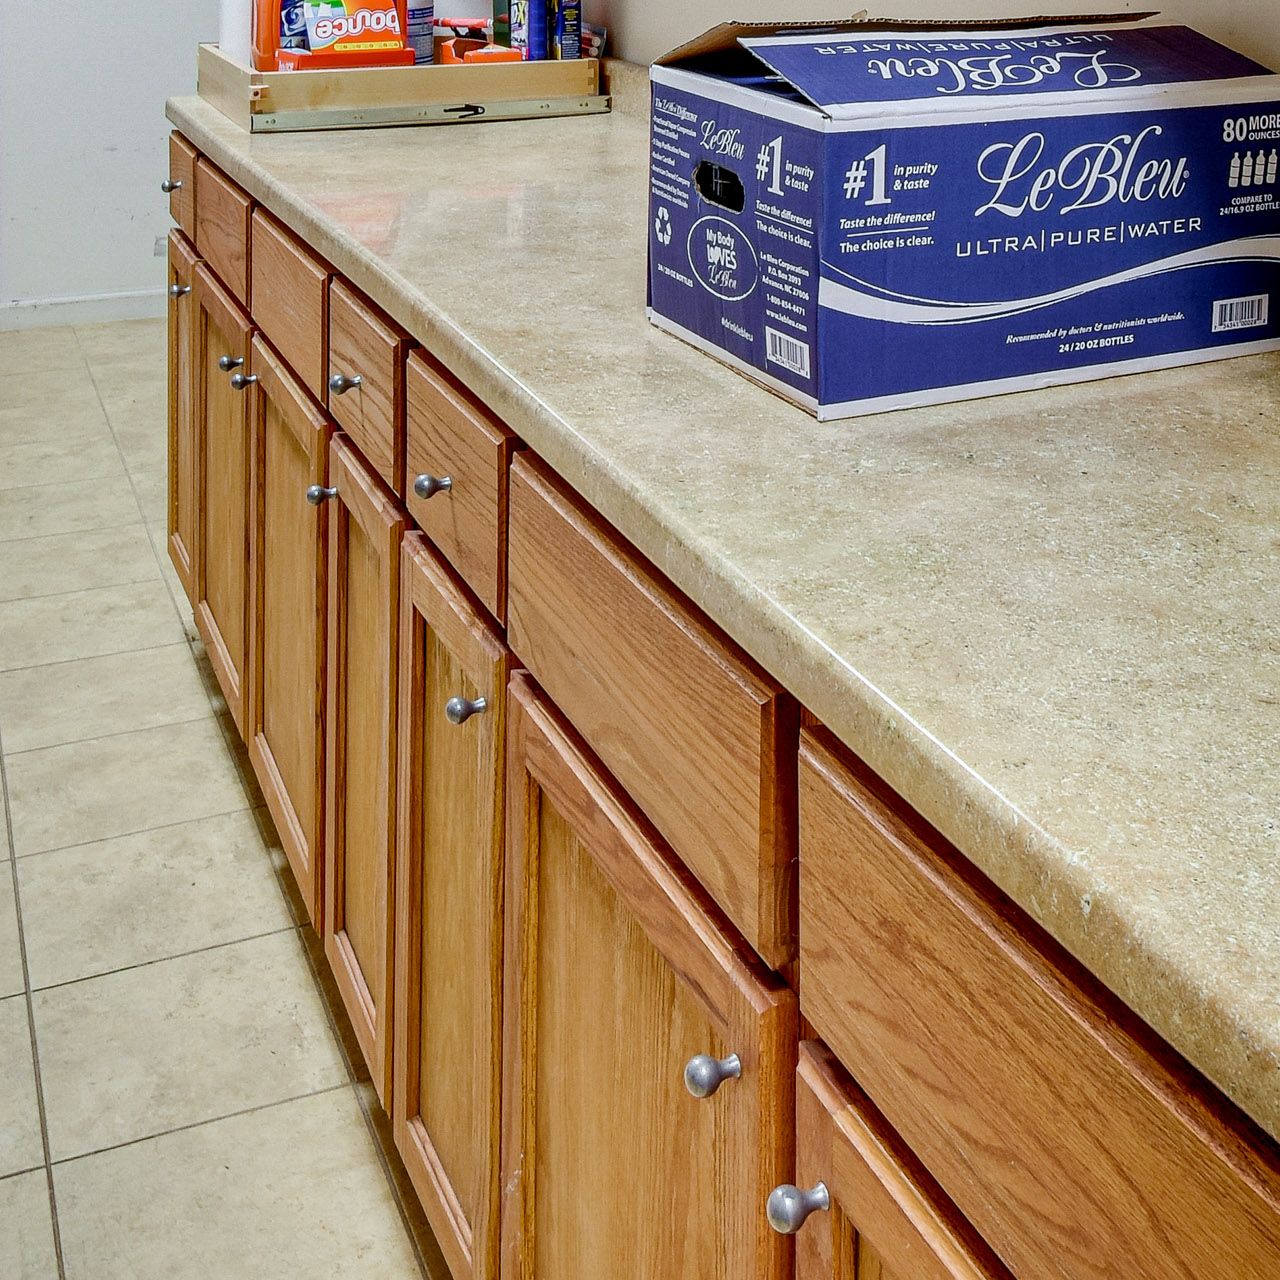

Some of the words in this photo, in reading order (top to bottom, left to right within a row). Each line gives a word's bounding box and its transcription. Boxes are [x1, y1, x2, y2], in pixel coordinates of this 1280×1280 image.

[316, 7, 401, 39] bounce
[1222, 118, 1248, 143] 80
[756, 135, 784, 196] #1
[785, 160, 792, 172] in
[792, 165, 814, 181] purity
[843, 144, 891, 206] #1
[893, 164, 904, 176] in
[905, 162, 938, 178] purity
[785, 175, 790, 186] &
[791, 176, 809, 192] taste
[893, 179, 901, 191] &
[903, 179, 930, 190] taste
[1231, 194, 1263, 206] COMPARE
[1264, 194, 1273, 202] TO
[756, 200, 770, 213] Taste
[770, 205, 780, 217] the
[780, 209, 812, 228] difference!
[1219, 205, 1245, 216] 24/16.9
[1245, 204, 1255, 213] OZ
[840, 218, 865, 230] Taste
[866, 215, 883, 227] the
[883, 210, 936, 225] difference!
[706, 228, 717, 246] My
[717, 231, 735, 250] Body
[756, 220, 767, 233] The
[768, 225, 787, 240] choice
[788, 231, 794, 241] is
[794, 235, 812, 249] clear.
[839, 242, 860, 253] The
[861, 238, 894, 251] choice
[895, 237, 905, 248] is
[906, 235, 935, 246] clear.
[778, 270, 788, 281] Box
[779, 258, 810, 277] Corporation
[676, 272, 694, 288] BOTTLES
[784, 283, 793, 295] NC
[1006, 328, 1057, 344] Recommended
[1058, 327, 1067, 339] by
[1068, 325, 1092, 336] doctors
[1093, 322, 1103, 332] &
[1103, 318, 1146, 331] nutritionists
[1147, 311, 1185, 324] worldwide.
[1086, 340, 1099, 349] OZ
[1099, 334, 1135, 348] BOTTLES
